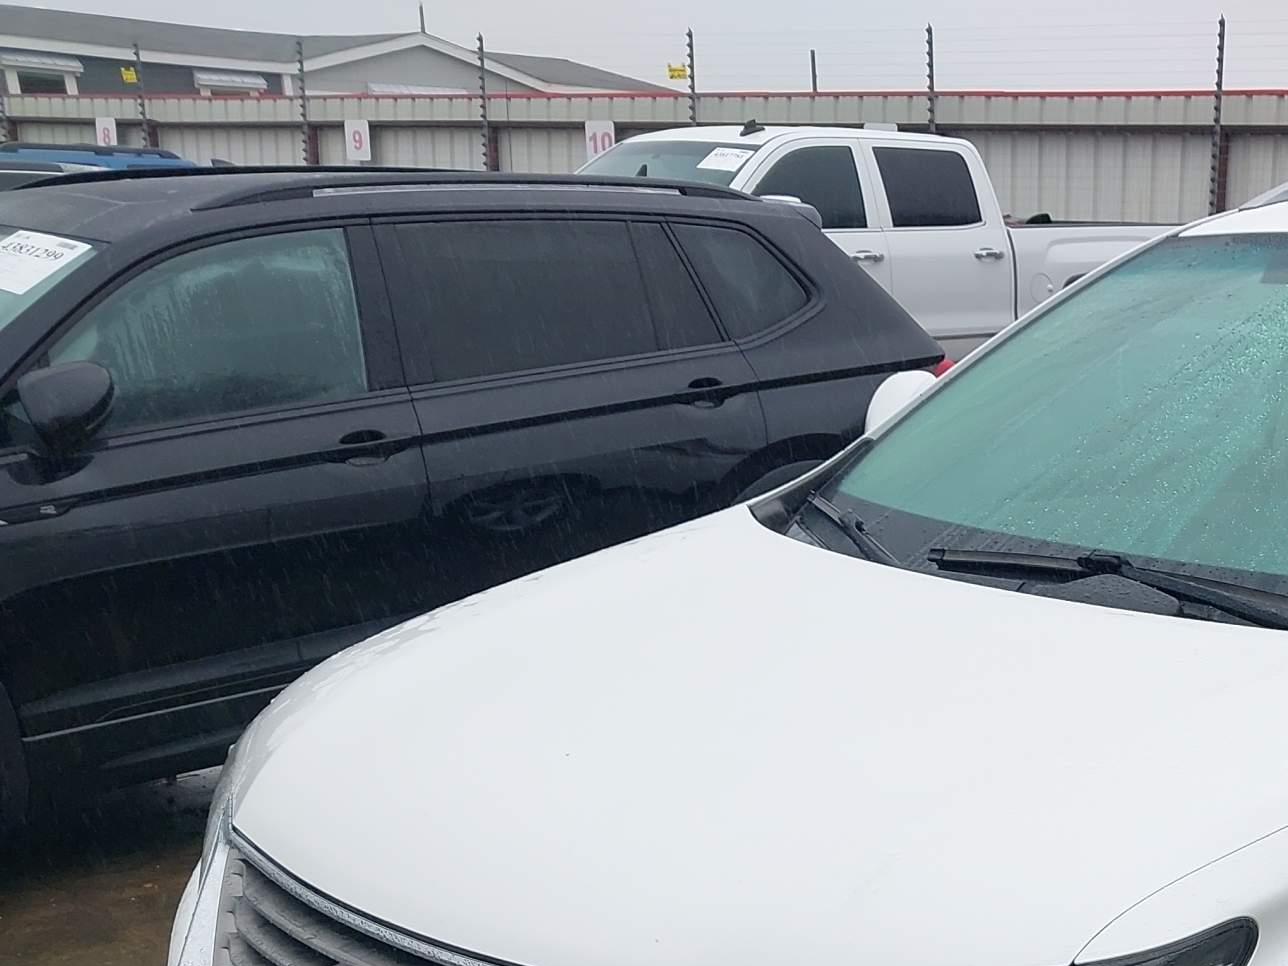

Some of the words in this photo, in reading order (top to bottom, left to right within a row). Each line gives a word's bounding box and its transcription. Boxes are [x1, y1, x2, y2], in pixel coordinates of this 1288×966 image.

[102, 127, 111, 145] 8
[352, 129, 363, 151] 9
[590, 131, 613, 154] 10
